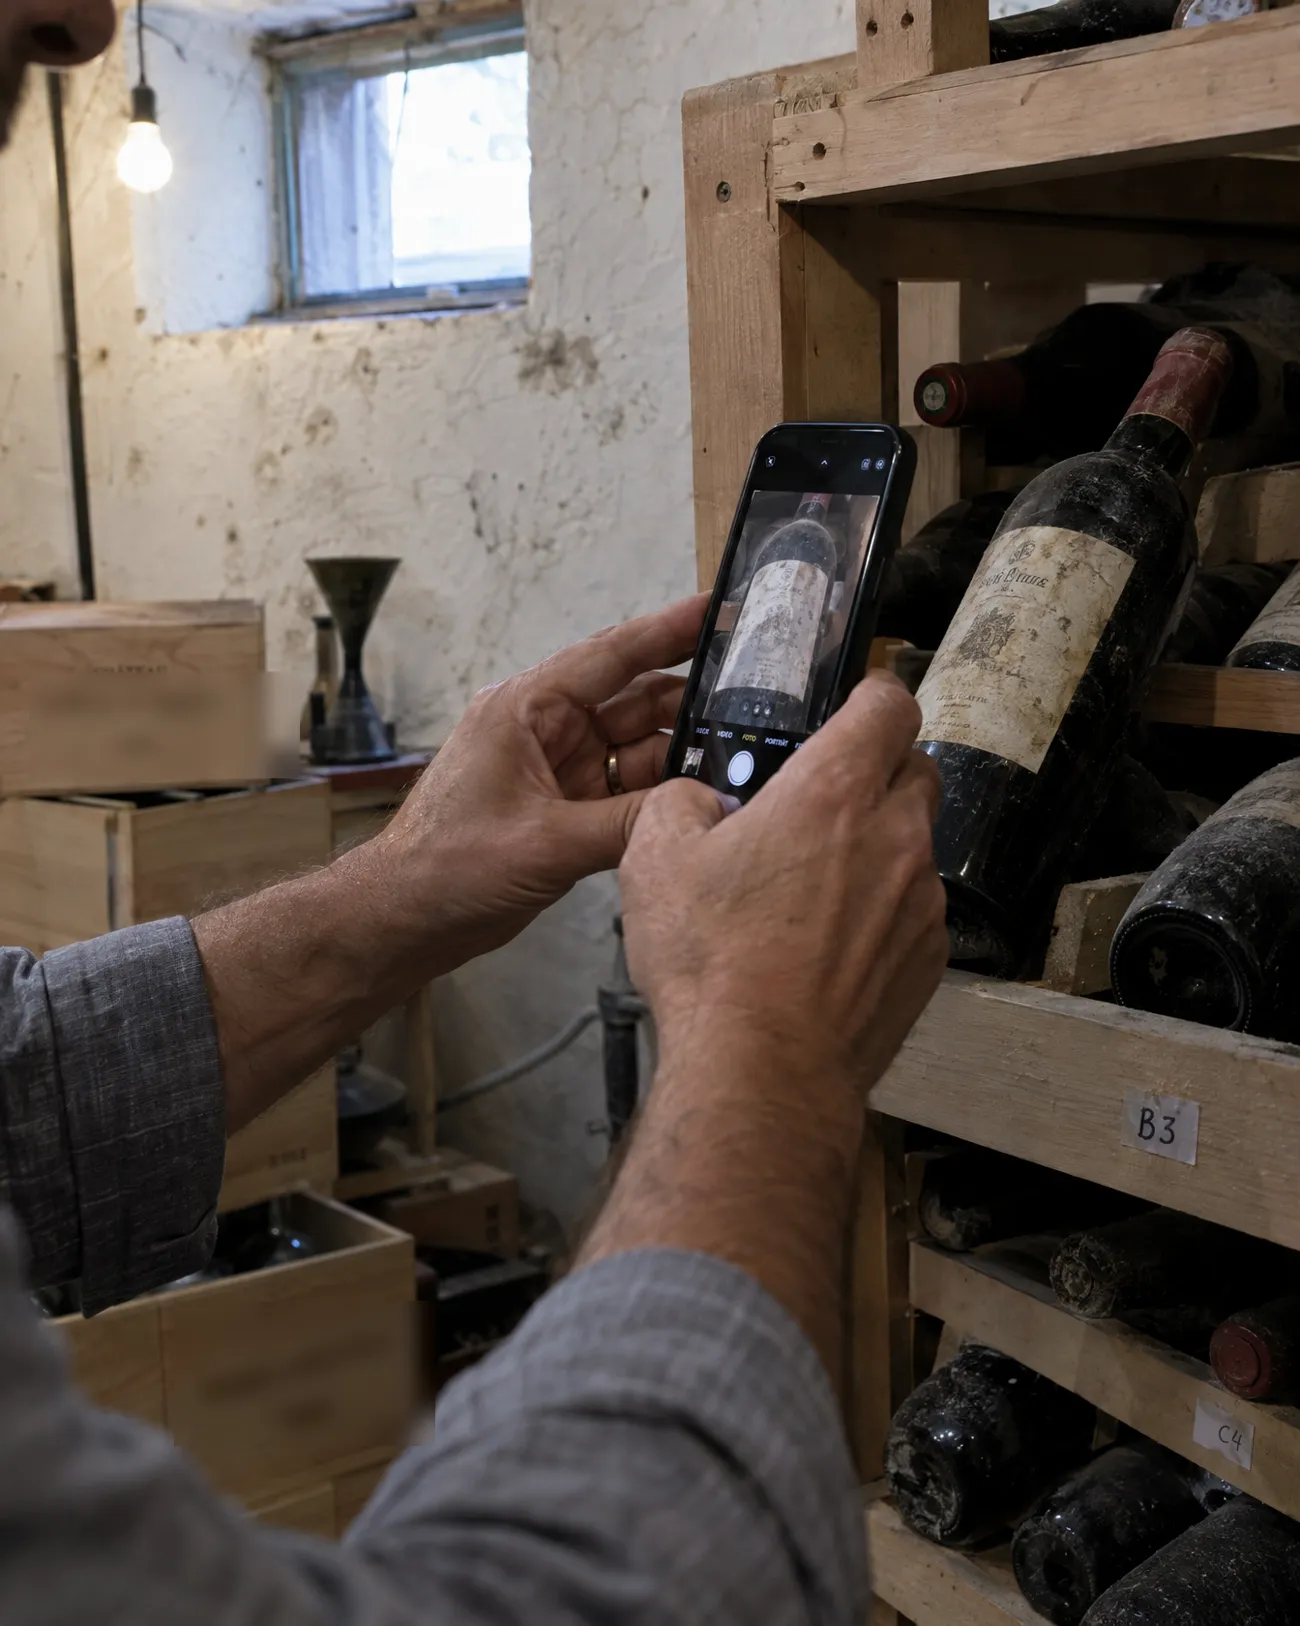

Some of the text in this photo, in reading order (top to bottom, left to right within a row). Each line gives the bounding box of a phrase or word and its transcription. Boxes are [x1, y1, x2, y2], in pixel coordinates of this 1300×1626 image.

[742, 733, 757, 742] FOTO
[1138, 1106, 1175, 1144] B3
[1218, 1425, 1242, 1451] C4
